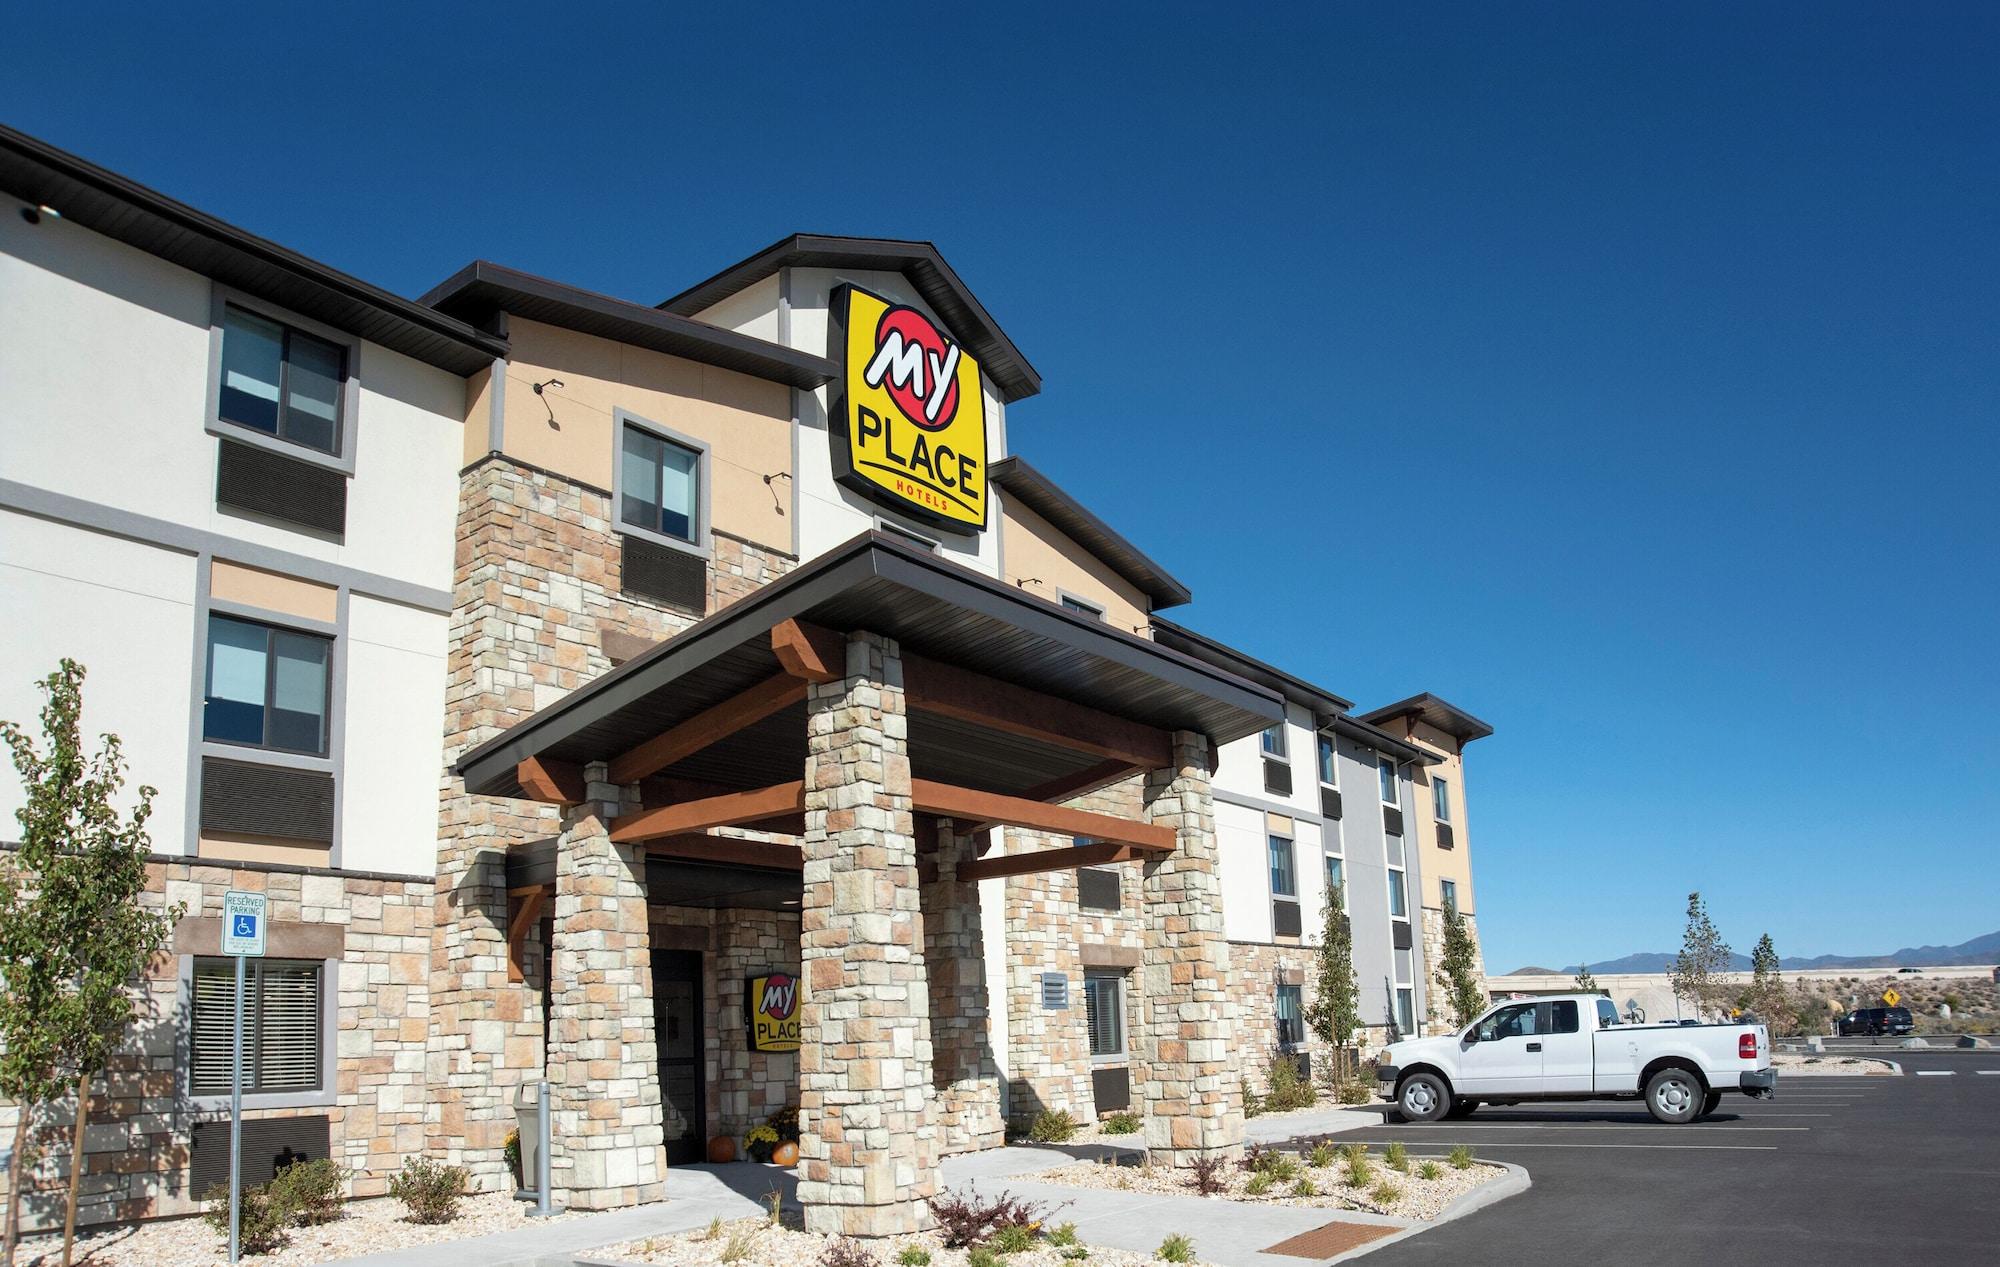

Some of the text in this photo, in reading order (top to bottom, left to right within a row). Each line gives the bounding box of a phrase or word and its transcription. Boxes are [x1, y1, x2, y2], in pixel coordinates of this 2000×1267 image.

[858, 404, 978, 500] PLACE
[896, 480, 948, 511] HOTELS
[227, 896, 264, 907] RESERVED
[231, 905, 261, 915] PARKING
